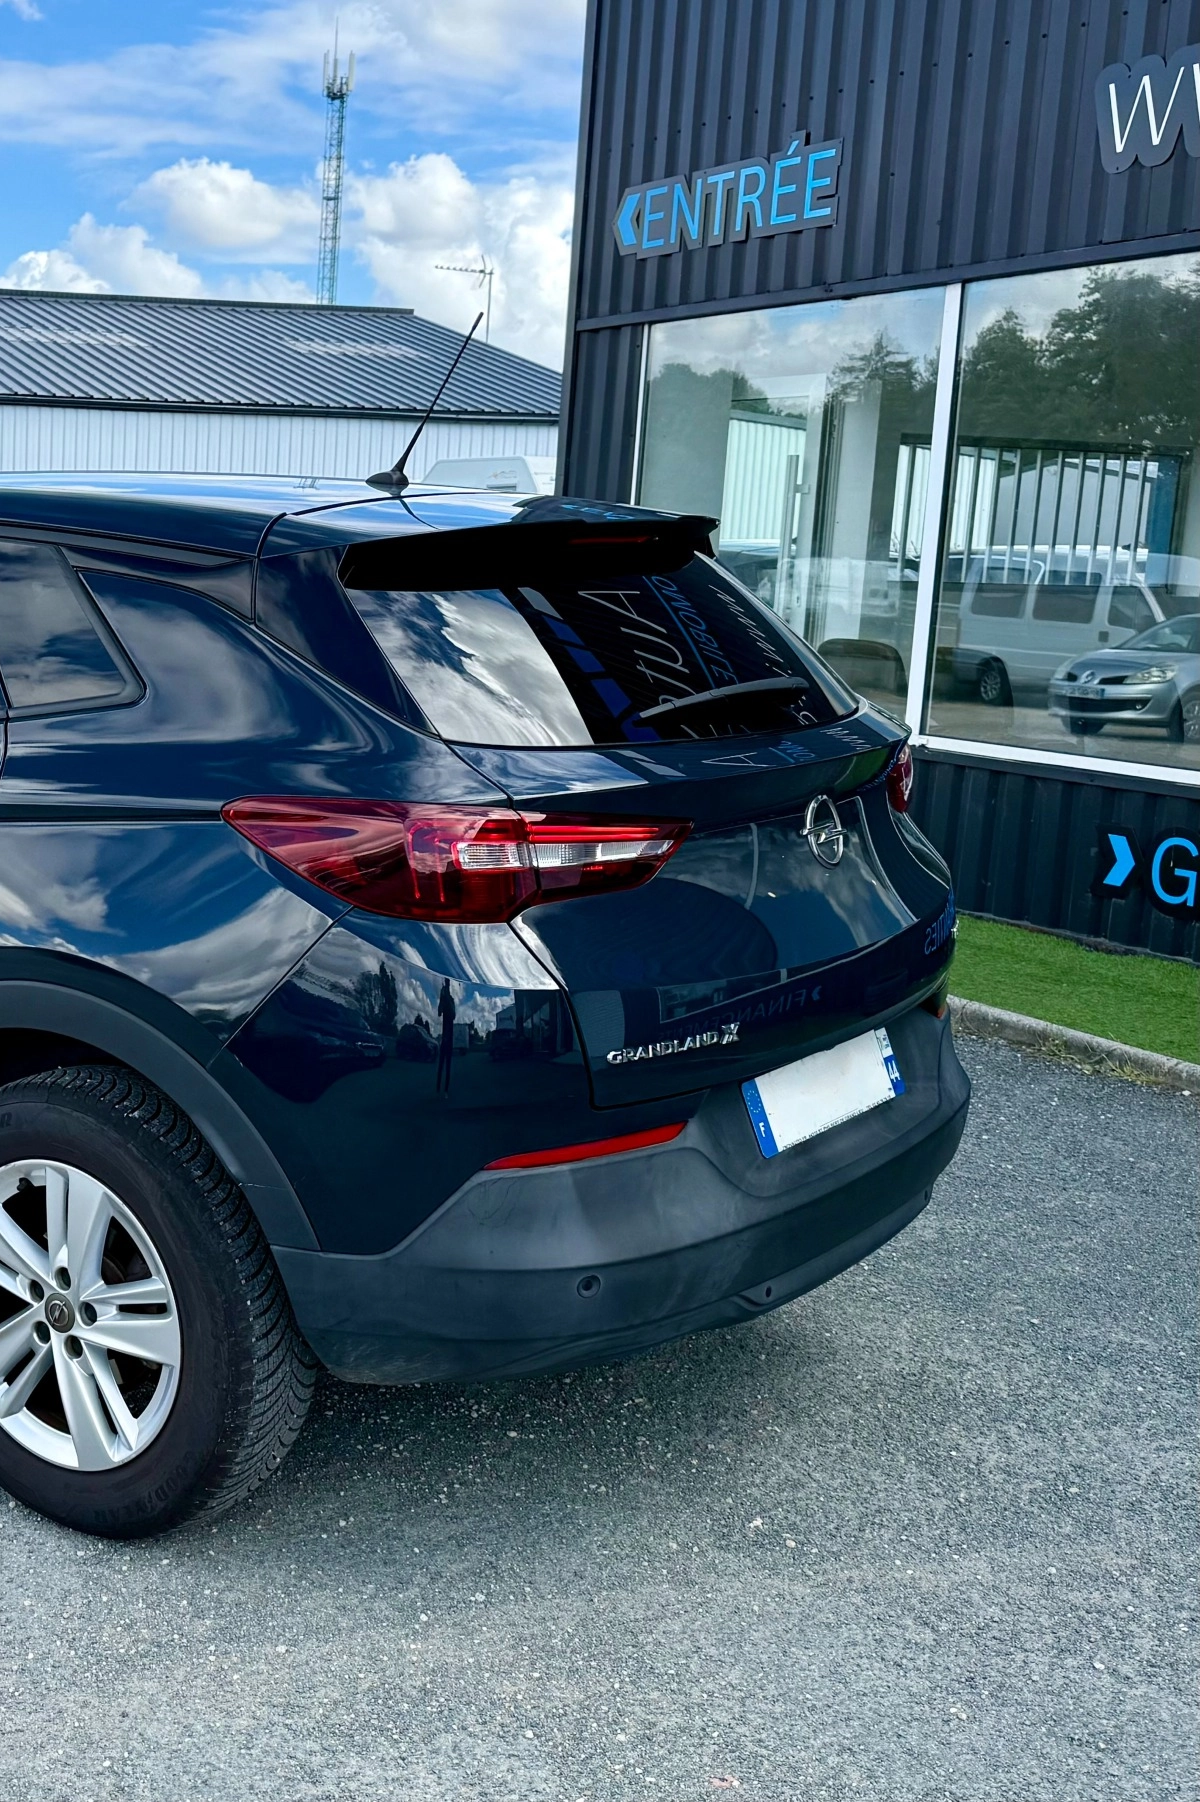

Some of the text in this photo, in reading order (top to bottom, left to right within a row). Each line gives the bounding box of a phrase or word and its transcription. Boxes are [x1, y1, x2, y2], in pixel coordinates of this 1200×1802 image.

[641, 139, 837, 249] ENTRÉE
[606, 1021, 741, 1065] GRANDLAND X
[886, 1060, 902, 1083] 44
[758, 1121, 767, 1138] F
